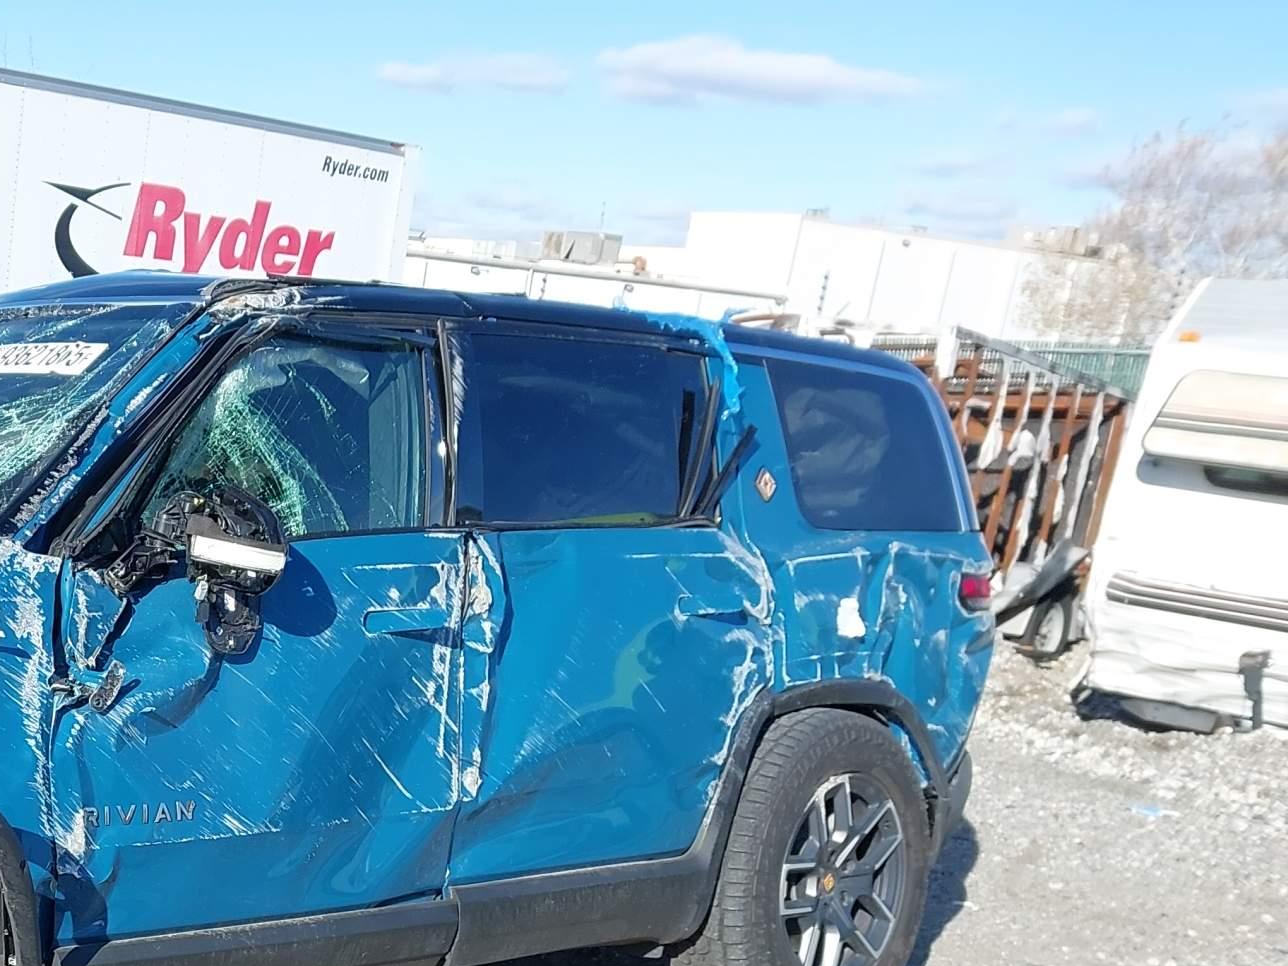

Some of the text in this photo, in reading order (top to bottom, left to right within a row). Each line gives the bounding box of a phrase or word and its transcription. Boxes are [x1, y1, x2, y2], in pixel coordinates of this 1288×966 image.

[322, 155, 389, 183] Ryder.com
[123, 182, 336, 277] Ryder
[83, 800, 196, 827] RIVIAN
